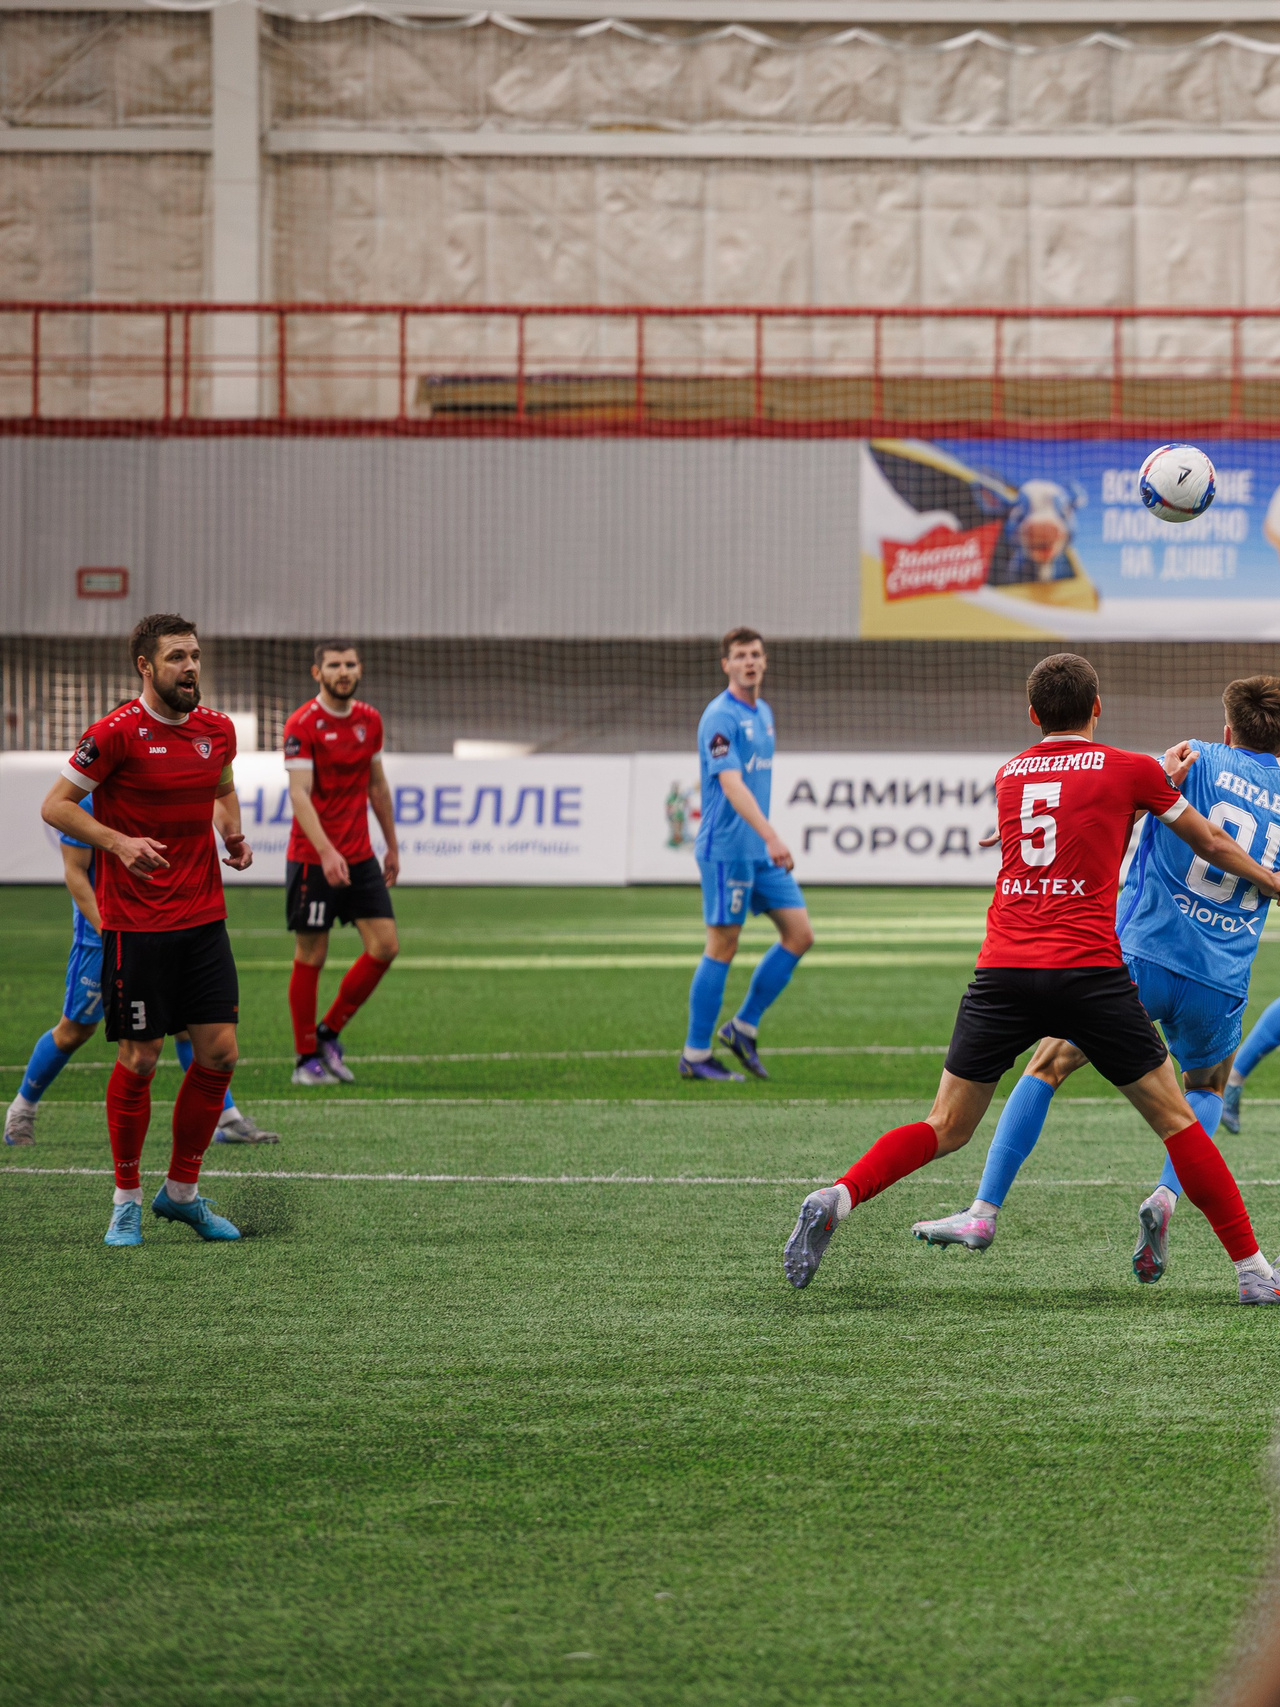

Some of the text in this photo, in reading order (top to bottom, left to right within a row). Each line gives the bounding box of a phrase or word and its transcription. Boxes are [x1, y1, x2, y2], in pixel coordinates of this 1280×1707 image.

[149, 746, 167, 754] JAKO
[1020, 782, 1062, 867] 5
[1002, 878, 1086, 896] GALTEX
[307, 901, 326, 926] 11
[1173, 893, 1260, 936] GloraX
[84, 990, 101, 1015] 7
[130, 1001, 146, 1030] 3
